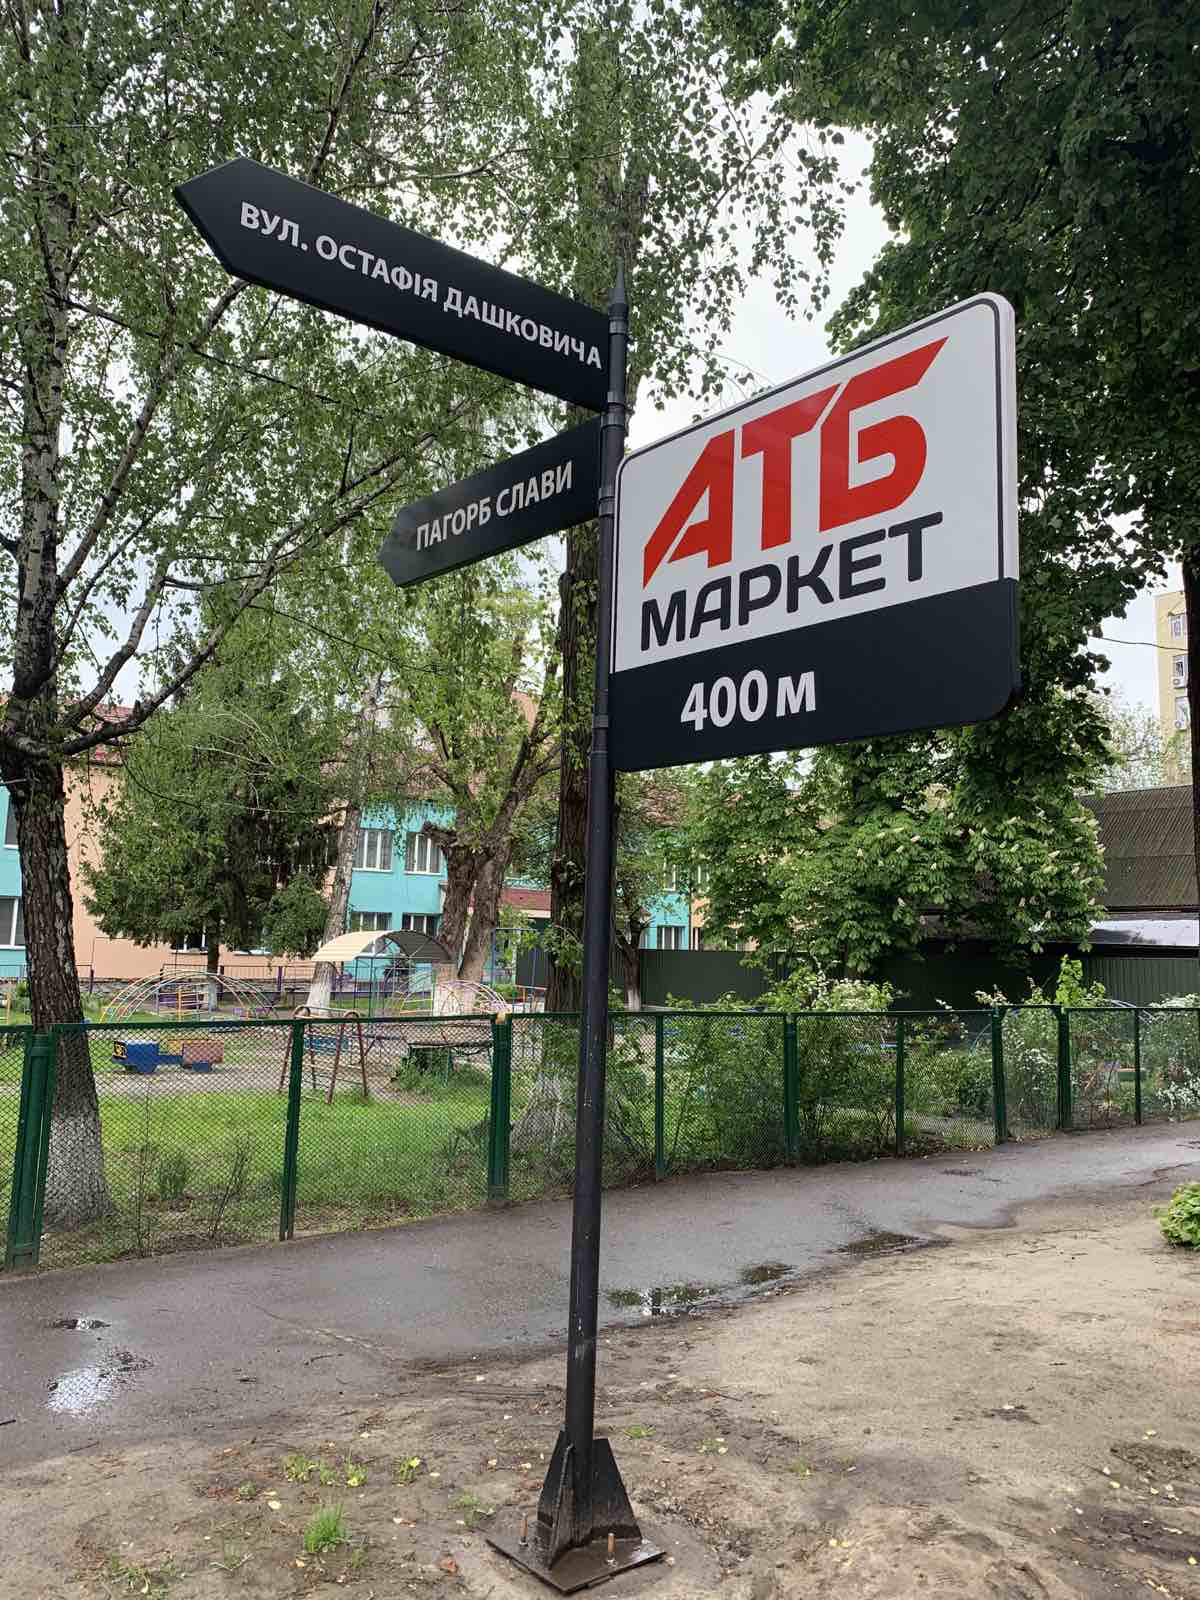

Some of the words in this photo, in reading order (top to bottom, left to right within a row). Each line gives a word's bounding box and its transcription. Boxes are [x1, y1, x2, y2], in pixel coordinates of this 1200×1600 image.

[240, 201, 308, 252] ВУЛ.
[316, 235, 438, 303] ОСТАФІЯ
[444, 285, 602, 368] ДАШКОВИЧА
[416, 498, 491, 551] ПАГОРБ
[496, 461, 573, 515] СЛАВИ
[642, 336, 949, 590] АТБ
[641, 511, 943, 651] МАРКЕТ
[681, 669, 768, 731] 400
